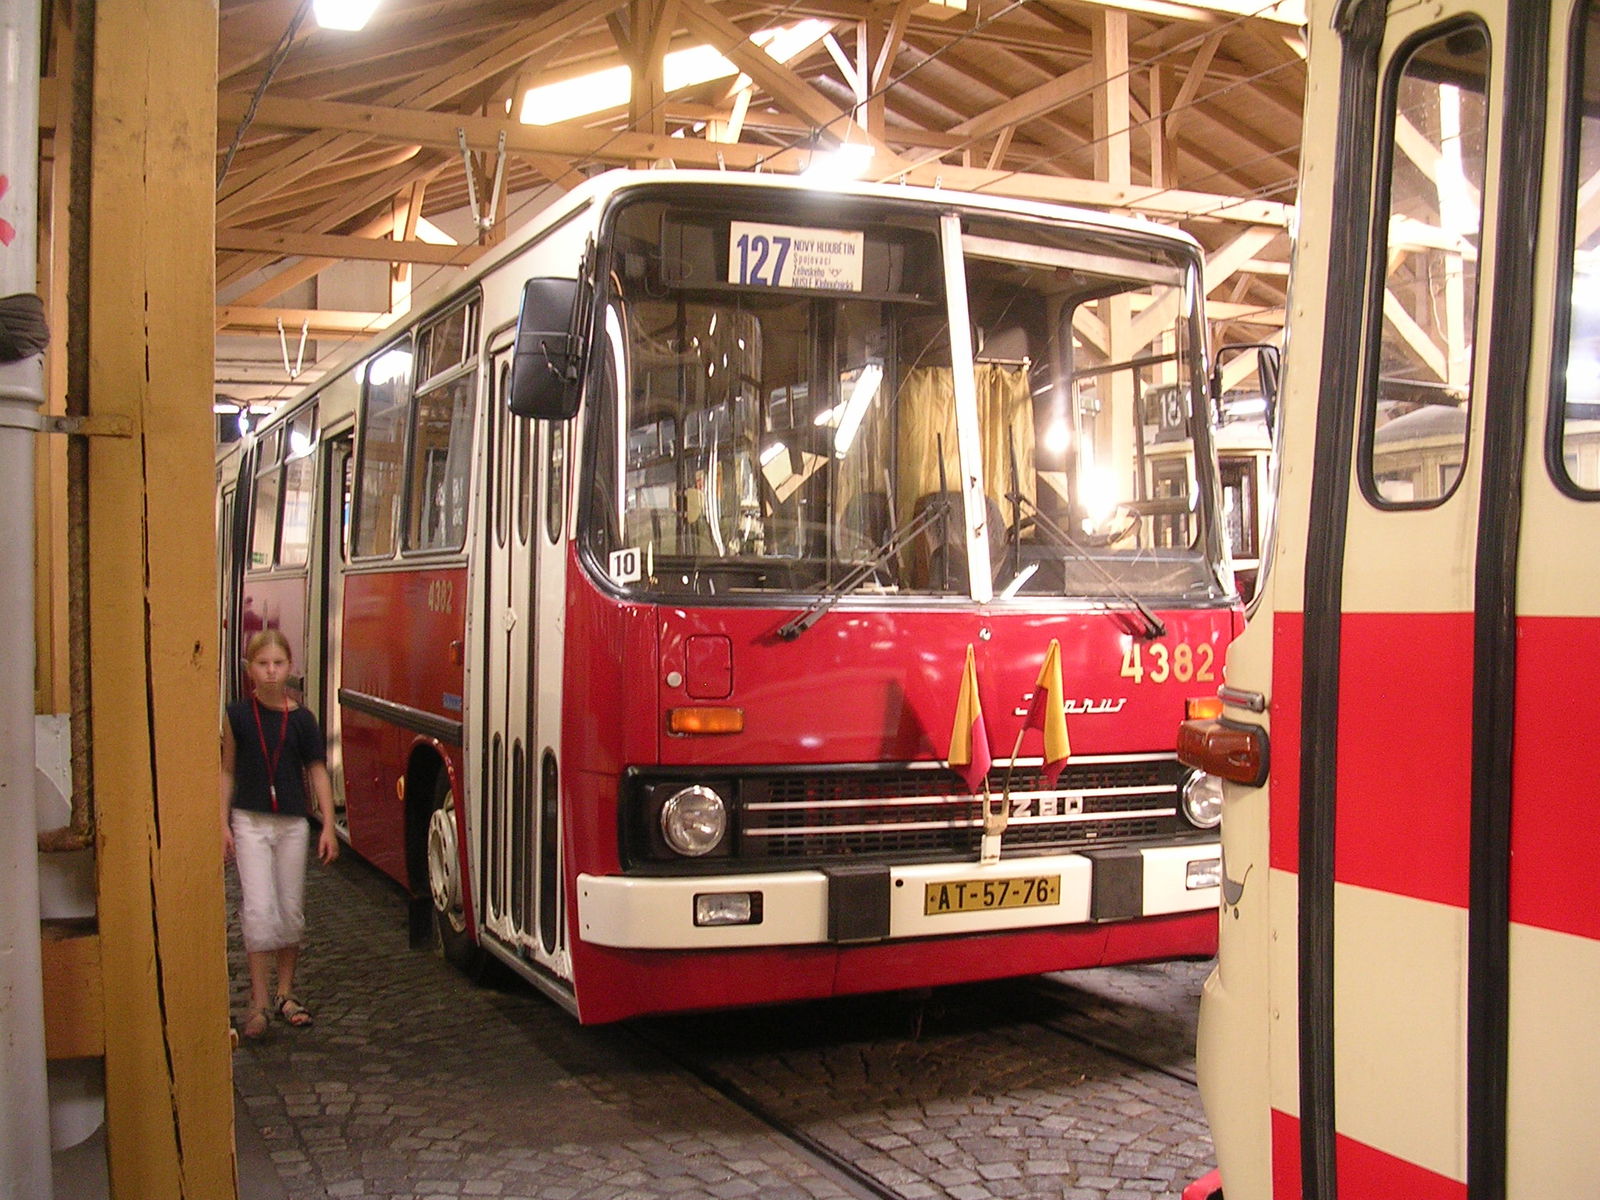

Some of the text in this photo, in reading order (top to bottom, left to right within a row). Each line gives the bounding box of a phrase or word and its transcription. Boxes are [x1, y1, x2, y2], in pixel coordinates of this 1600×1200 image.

[737, 234, 791, 287] 127
[614, 552, 635, 577] 10
[428, 580, 453, 614] 4382
[1121, 643, 1215, 684] 4382
[939, 879, 1048, 910] AT-57-76
